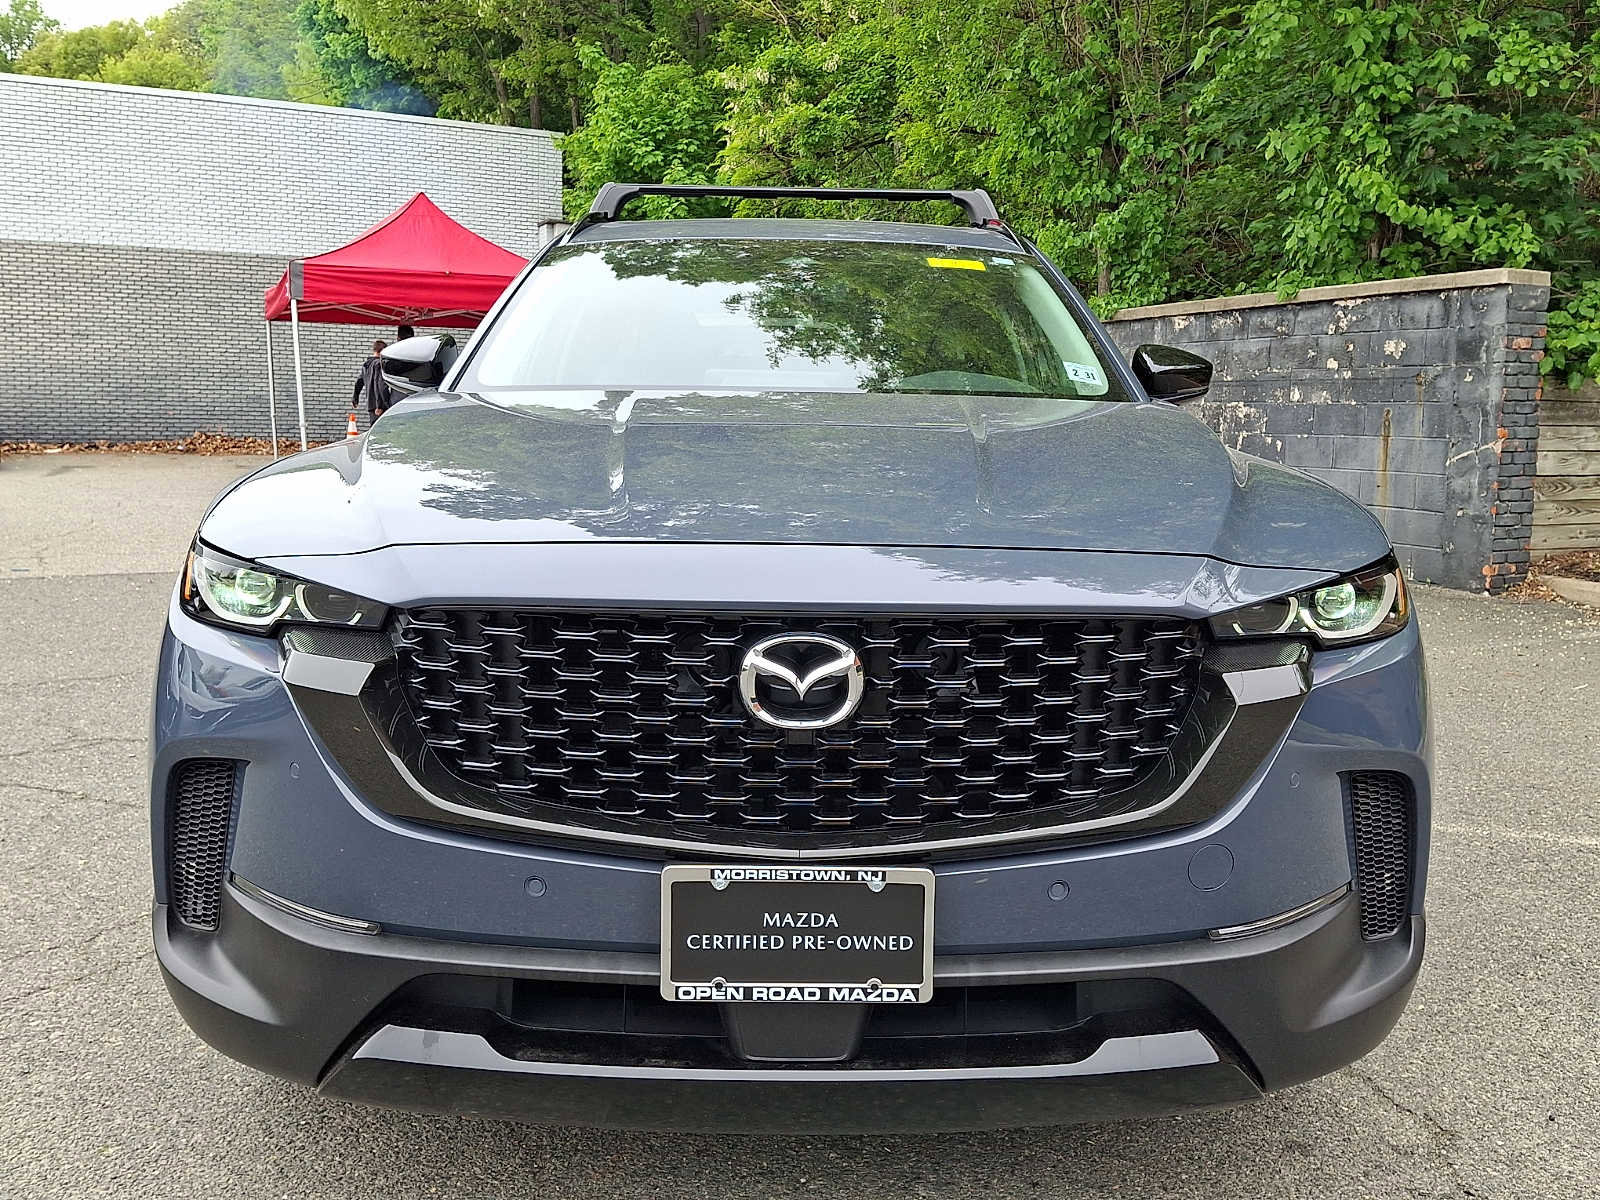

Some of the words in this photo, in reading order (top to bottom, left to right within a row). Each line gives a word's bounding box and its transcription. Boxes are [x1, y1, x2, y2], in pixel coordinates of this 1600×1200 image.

[713, 869, 851, 881] MORRISTOWN,
[857, 870, 883, 882] NJ
[763, 912, 839, 928] MAZDA
[686, 934, 784, 950] CERTIFIED
[792, 935, 914, 951] PRE-OWNED
[678, 986, 744, 1000] OPEN
[752, 987, 821, 1001] ROAD
[828, 988, 917, 1002] MAZDA
